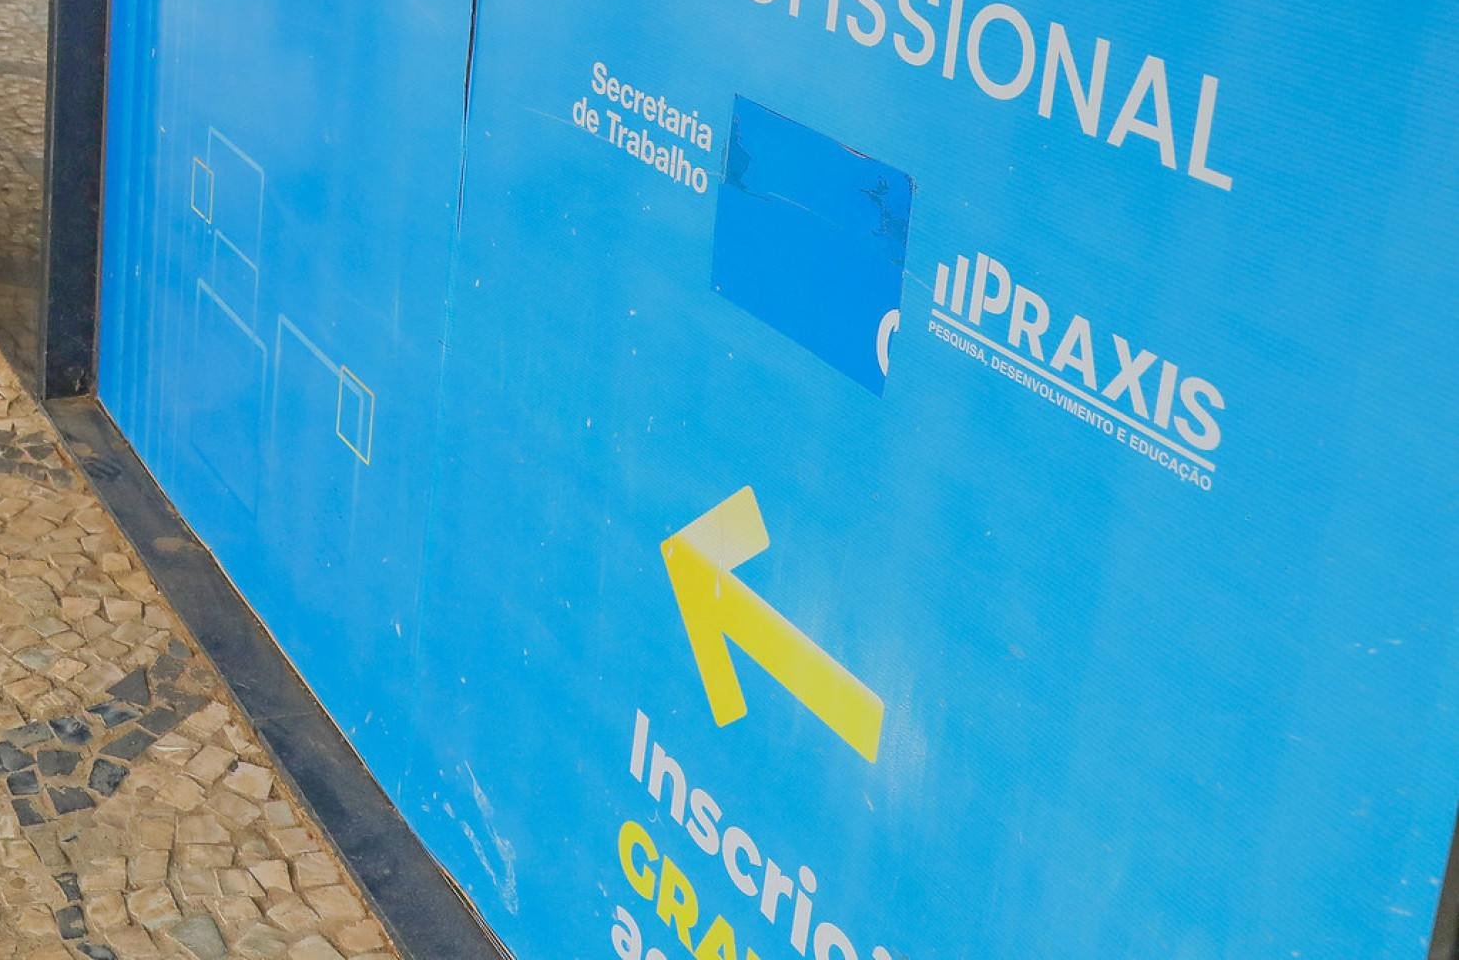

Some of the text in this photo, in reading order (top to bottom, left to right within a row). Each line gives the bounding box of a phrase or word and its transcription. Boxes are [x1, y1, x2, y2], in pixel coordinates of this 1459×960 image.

[572, 97, 708, 194] de Trabalho
[591, 61, 712, 152] Secretaria
[928, 319, 989, 368] PESQUISA,
[991, 357, 1114, 436] DESENVOLVIMENTO
[1116, 427, 1128, 444] E
[1129, 435, 1213, 492] EDUCAÇÃO
[629, 707, 893, 960] Inscri
